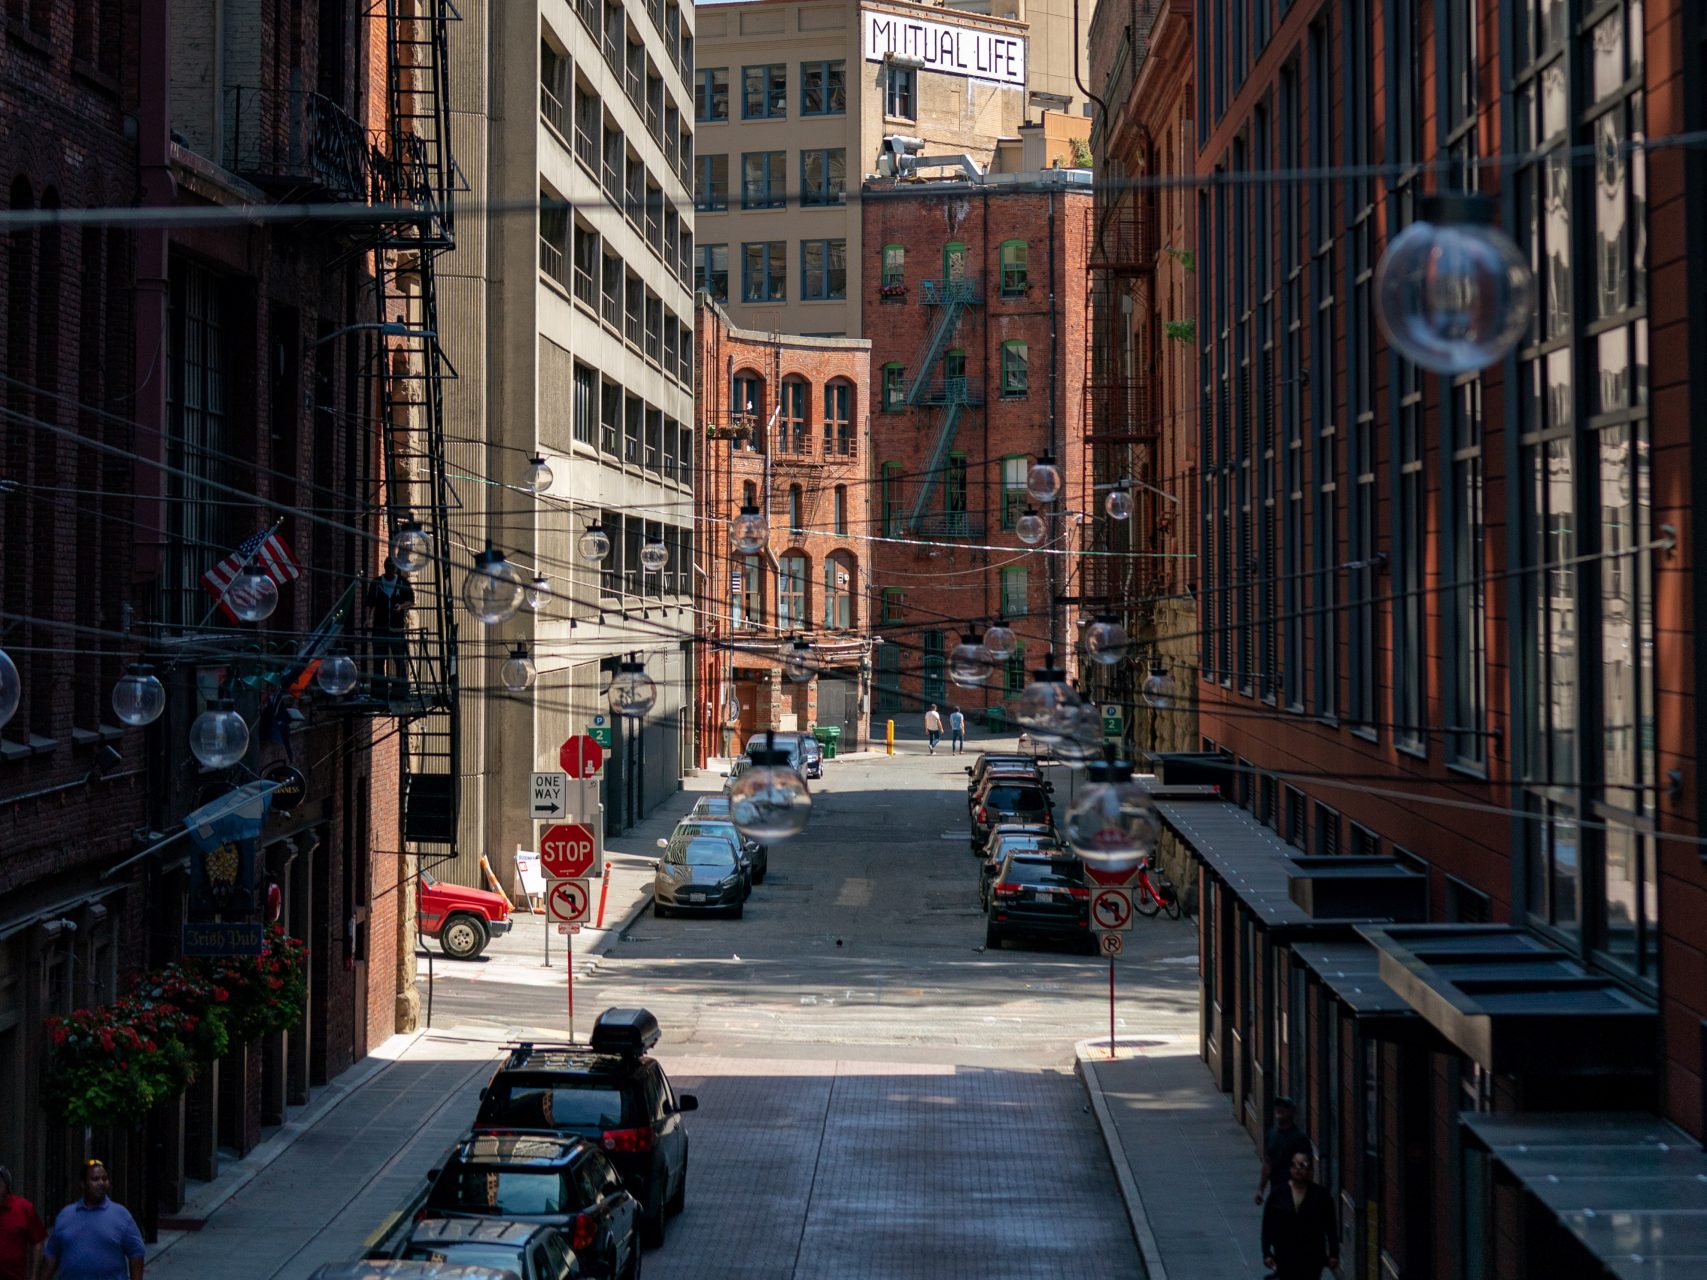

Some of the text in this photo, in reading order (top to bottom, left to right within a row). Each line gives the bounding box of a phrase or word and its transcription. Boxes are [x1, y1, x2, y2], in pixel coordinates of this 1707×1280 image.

[873, 17, 1017, 76] MUTUAL LIFE
[1108, 719, 1115, 729] 2
[596, 730, 604, 740] 2
[536, 776, 560, 787] ONE
[535, 788, 561, 799] WAY
[544, 841, 591, 862] STOP
[187, 928, 258, 950] Irish Pub
